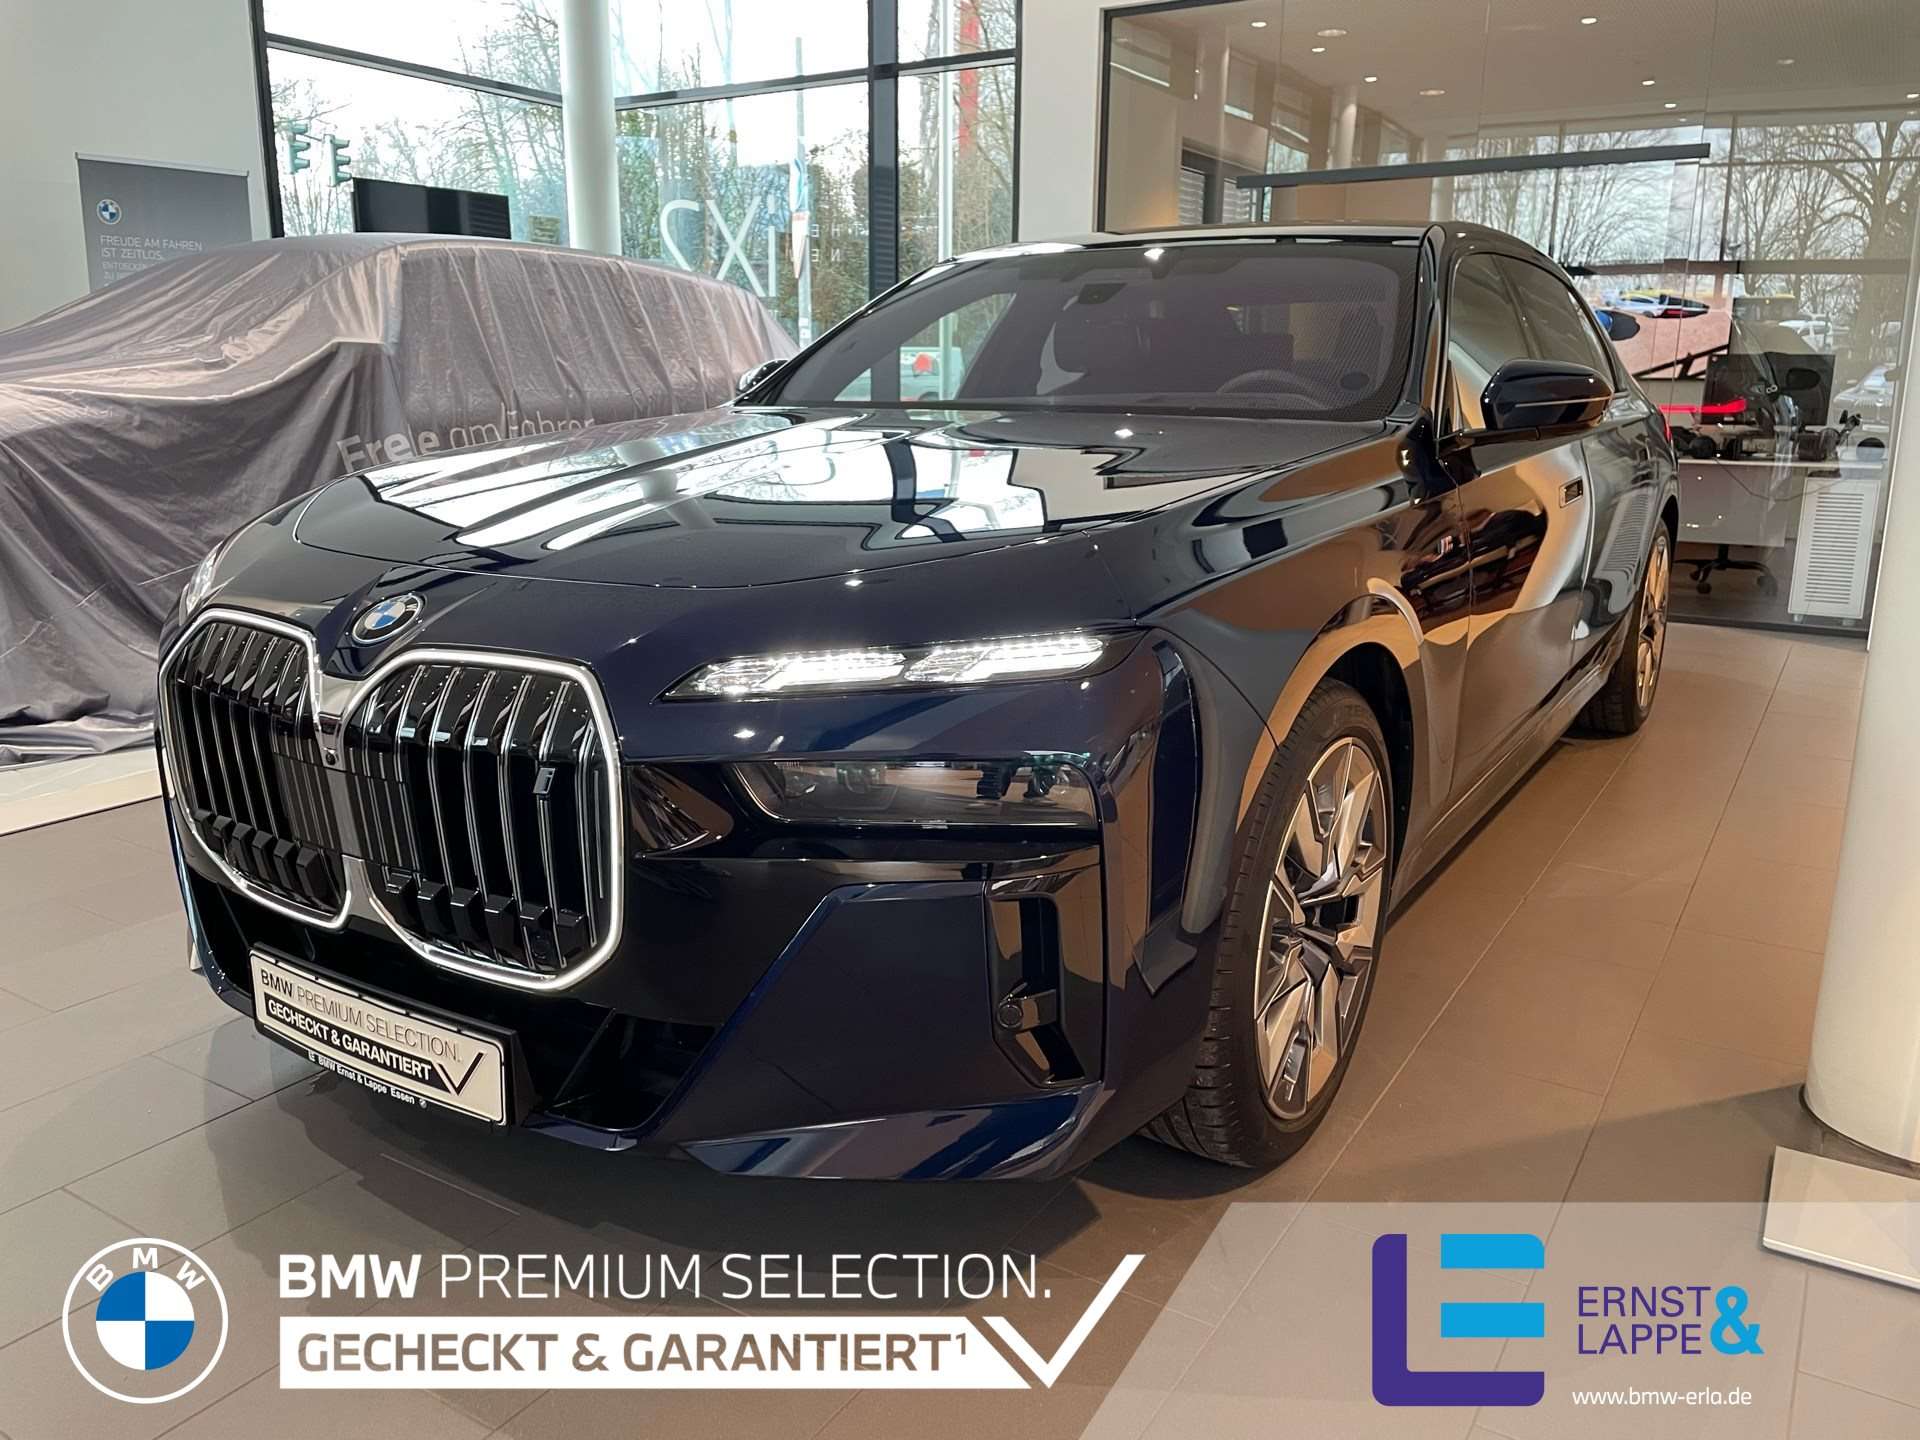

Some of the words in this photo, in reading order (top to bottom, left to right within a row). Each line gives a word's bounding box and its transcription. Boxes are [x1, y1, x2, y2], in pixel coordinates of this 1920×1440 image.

[100, 234, 141, 248] FREUDE
[144, 238, 159, 249] AM
[162, 239, 202, 252] FAHREN
[101, 247, 116, 258] IST
[260, 968, 293, 998] BMW
[297, 985, 362, 1028] PREMIUM
[268, 999, 330, 1041] GECHECKT
[331, 1029, 341, 1046] &
[342, 1033, 432, 1081] GARANTIERT
[336, 1063, 356, 1081] Ernst
[364, 1077, 388, 1094] Lappe
[390, 1087, 415, 1105] Essen
